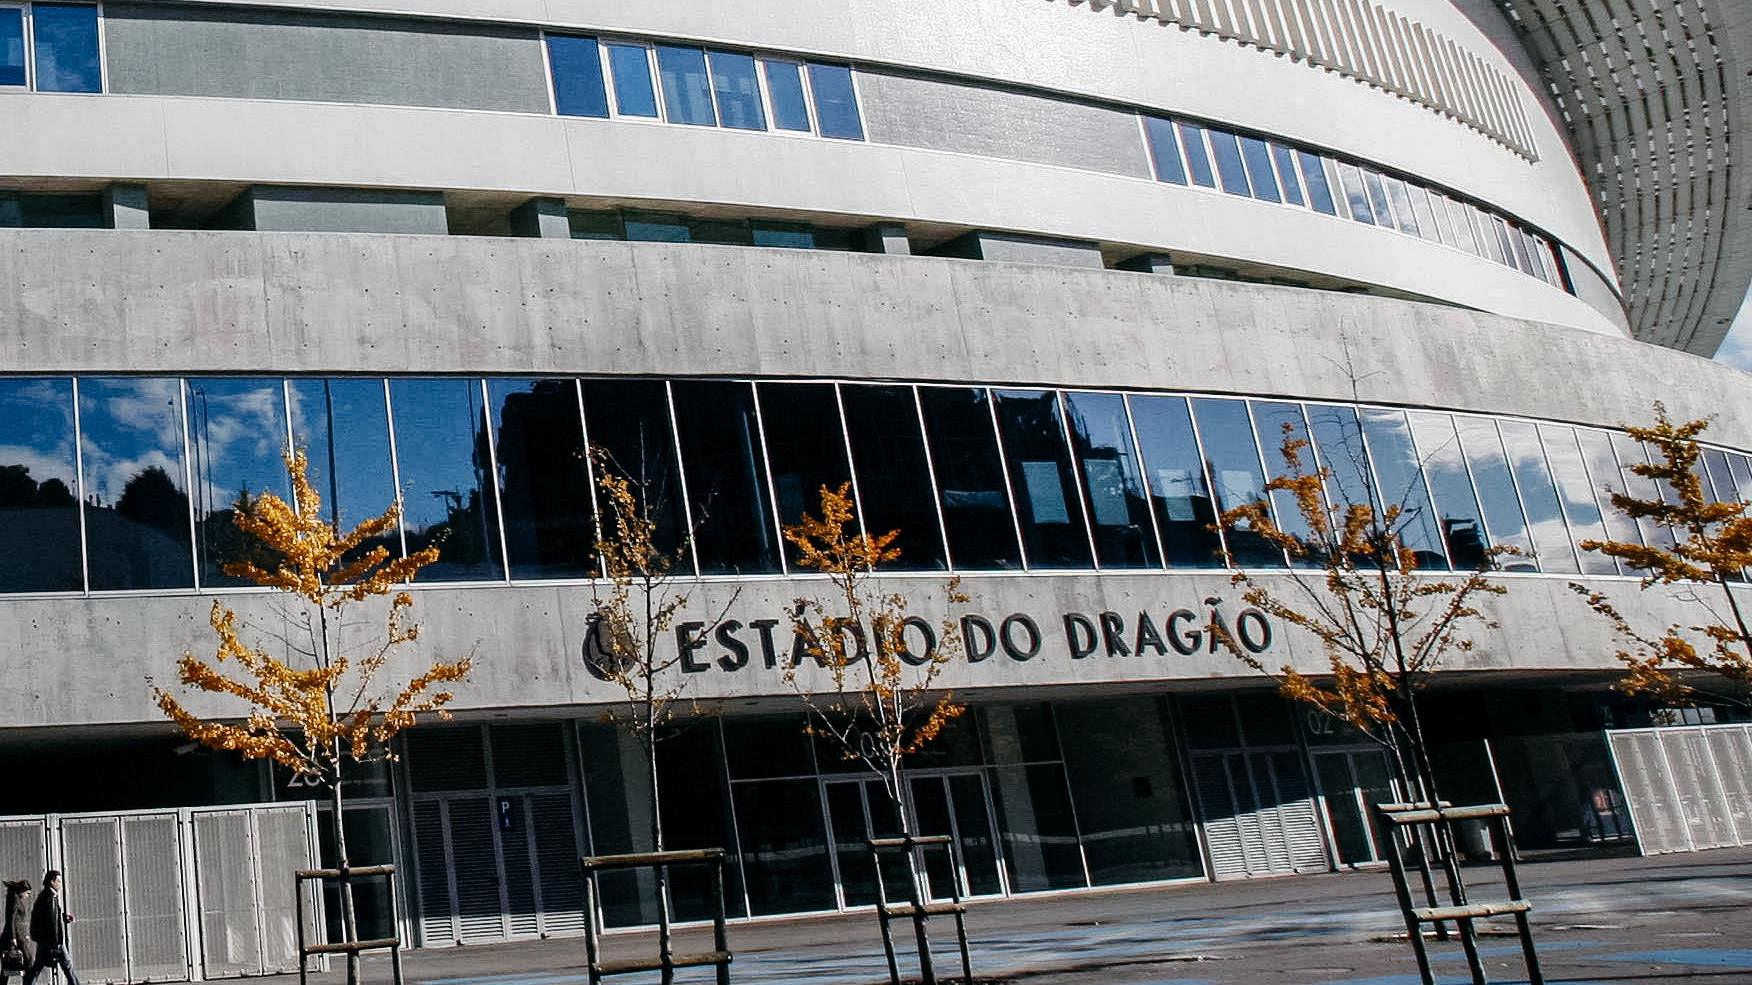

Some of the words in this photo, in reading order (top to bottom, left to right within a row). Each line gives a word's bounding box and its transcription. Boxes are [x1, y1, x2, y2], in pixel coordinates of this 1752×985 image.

[674, 598, 937, 673] ESTÁDIO
[959, 612, 1042, 663] DO
[1062, 596, 1273, 660] DRAGÃO
[501, 801, 510, 814] P
